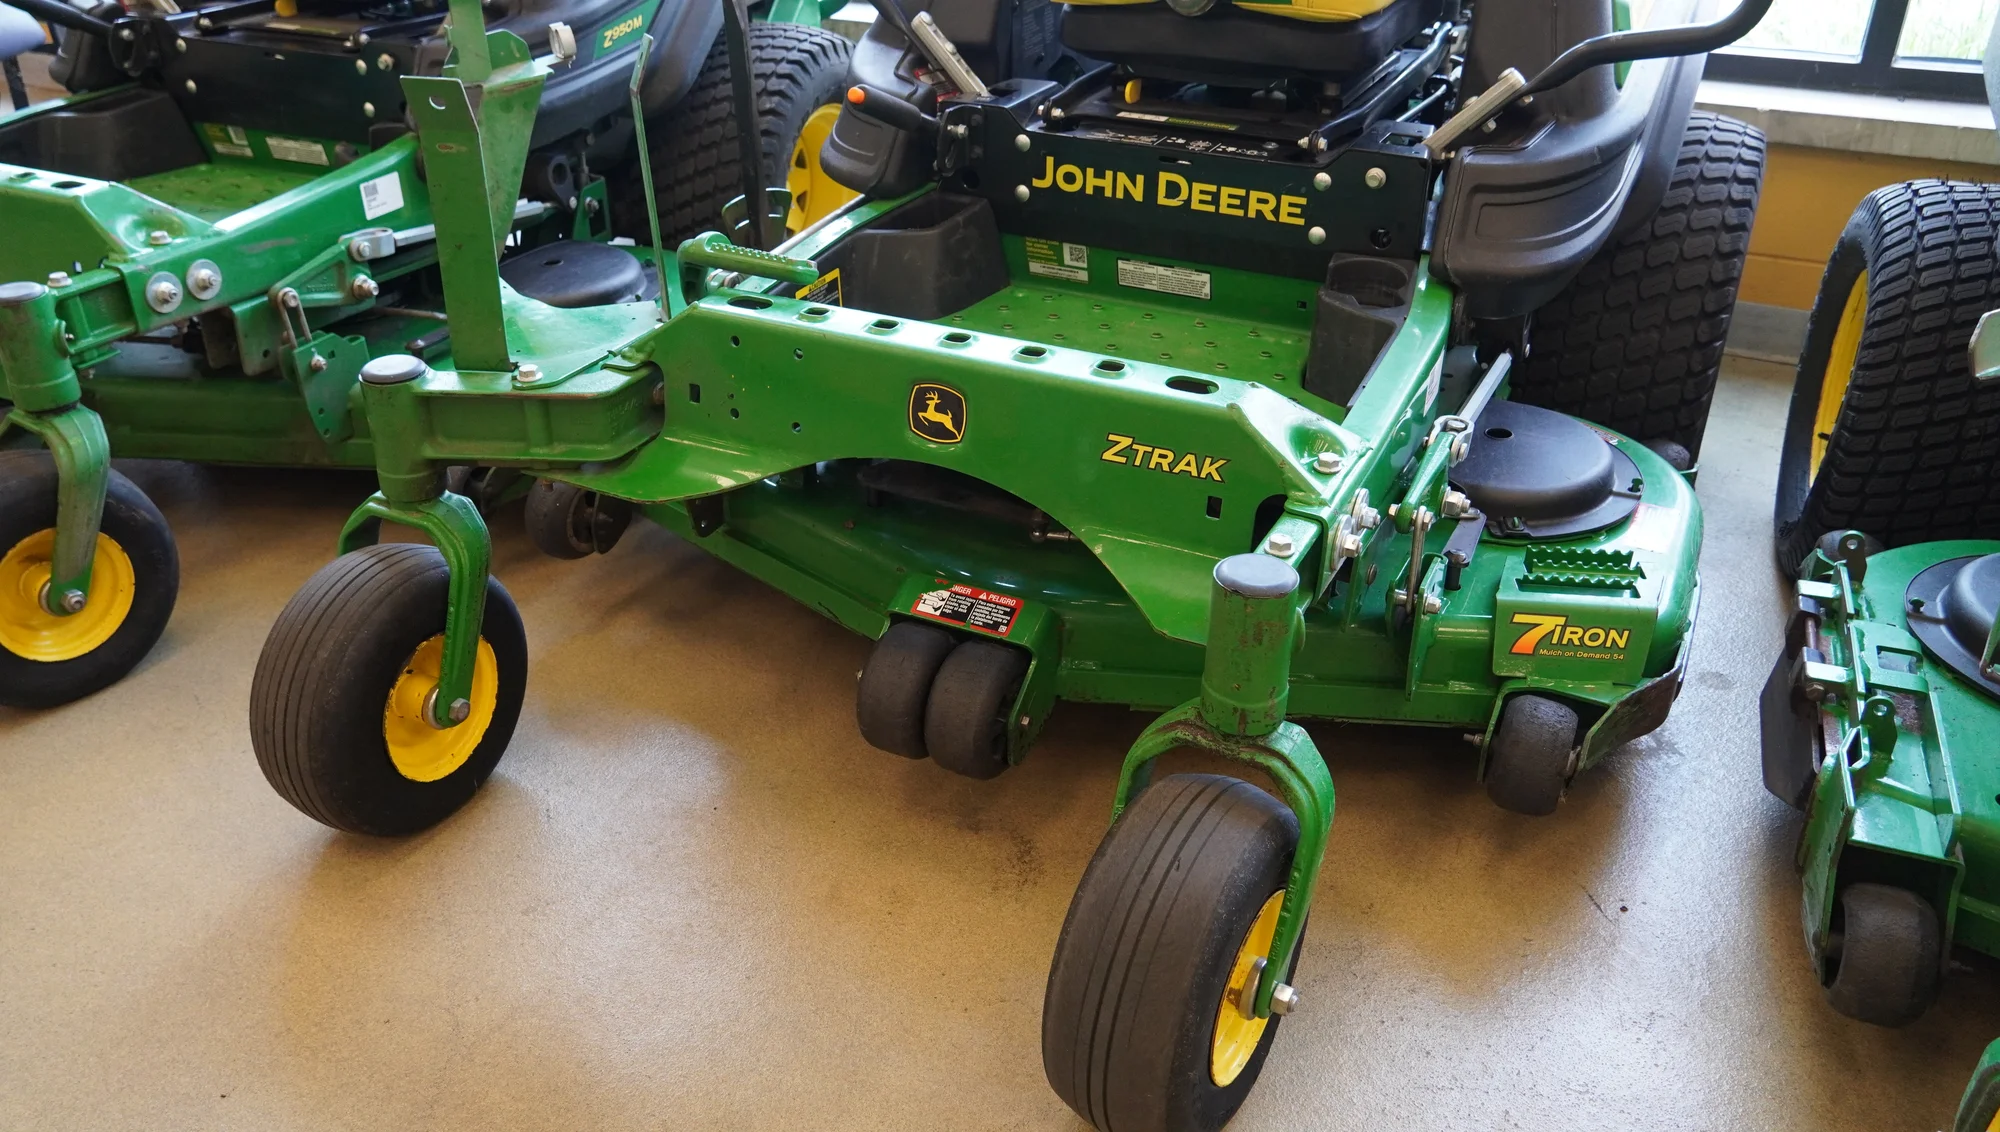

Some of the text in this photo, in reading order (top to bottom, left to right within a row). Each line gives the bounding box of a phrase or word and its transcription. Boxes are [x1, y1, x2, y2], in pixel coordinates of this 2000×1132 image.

[603, 15, 643, 49] Z950M
[1032, 156, 1308, 226] JOHN DEERE
[1101, 432, 1231, 483] ZTRAK
[988, 593, 1017, 606] PELIGRO
[1539, 648, 1563, 657] Mulch
[1576, 651, 1611, 660] Demand
